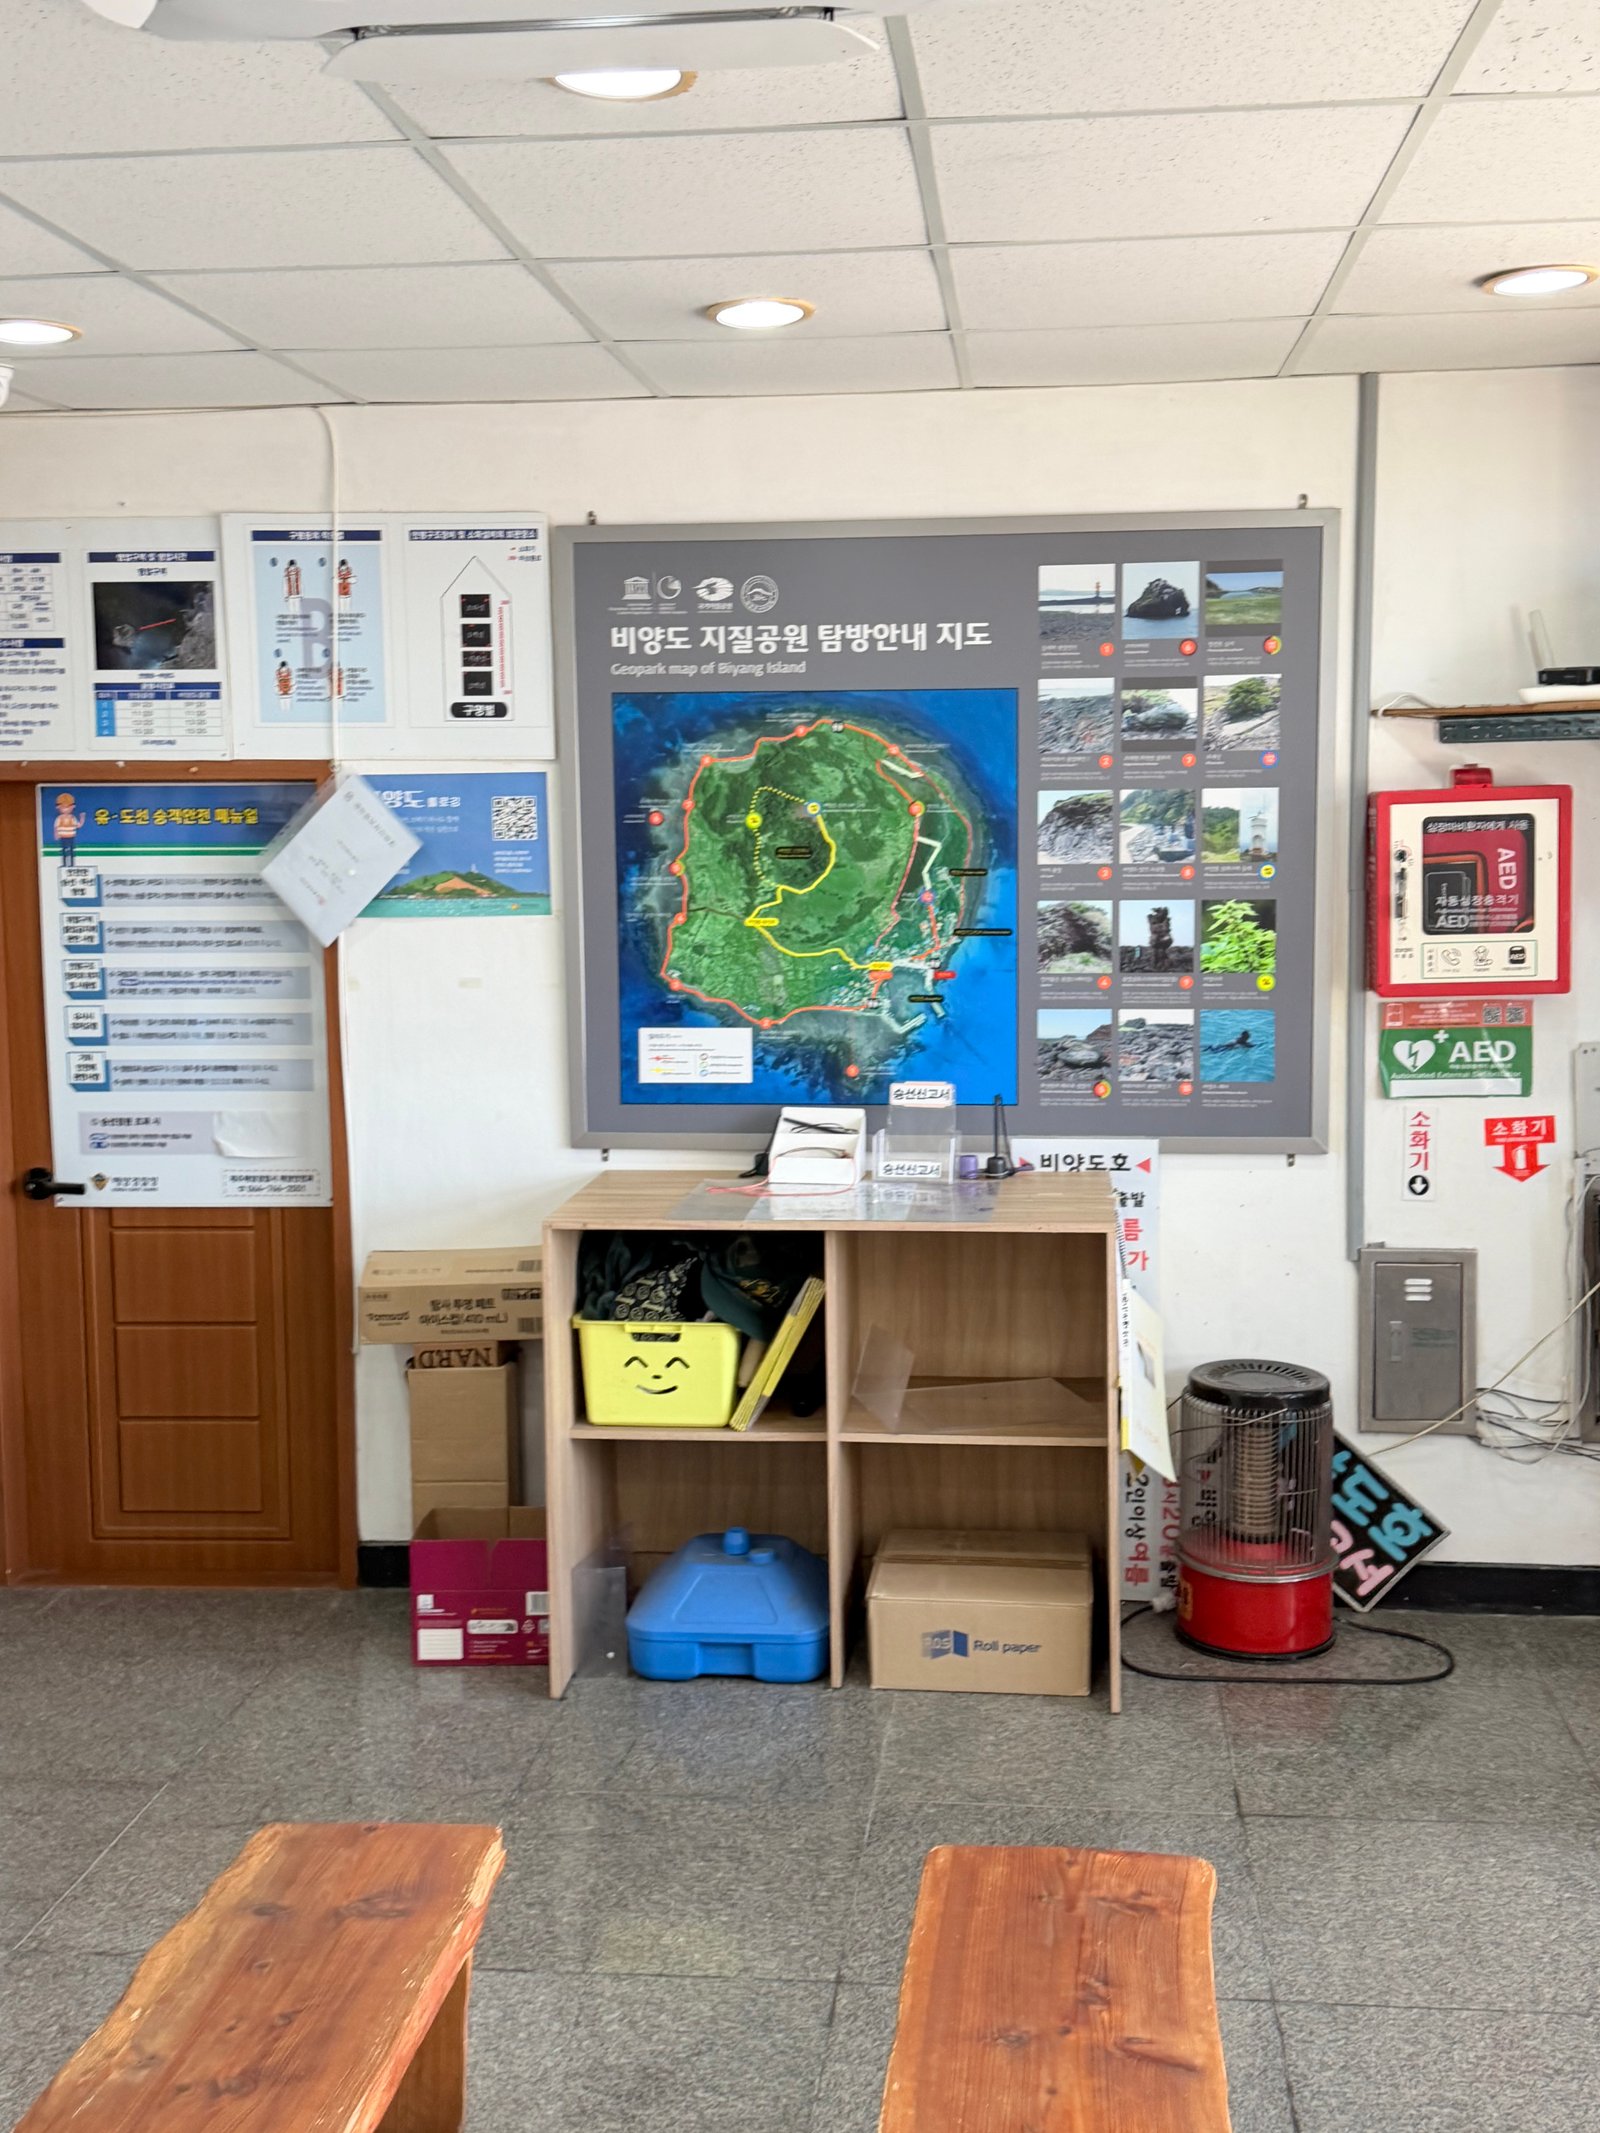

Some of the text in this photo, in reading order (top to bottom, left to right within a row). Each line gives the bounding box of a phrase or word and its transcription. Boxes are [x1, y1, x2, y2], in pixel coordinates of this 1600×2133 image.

[610, 621, 993, 656] 비양도 지질공원 탐방안내 지도
[610, 660, 806, 678] Geopark map of Biyang Island
[374, 790, 425, 808] 양도
[1496, 848, 1518, 890] AED
[1436, 914, 1470, 928] AED
[1448, 1040, 1517, 1063] AED
[894, 1087, 950, 1100] 승선신고서
[1492, 1119, 1548, 1136] 소화기
[1408, 1110, 1432, 1172] 소화기
[883, 1163, 940, 1176] 승선신고서
[1040, 1152, 1133, 1173] 비양도호
[418, 1347, 493, 1369] NARD
[1331, 1450, 1434, 1562] 도호
[972, 1640, 1042, 1654] Roll paper
